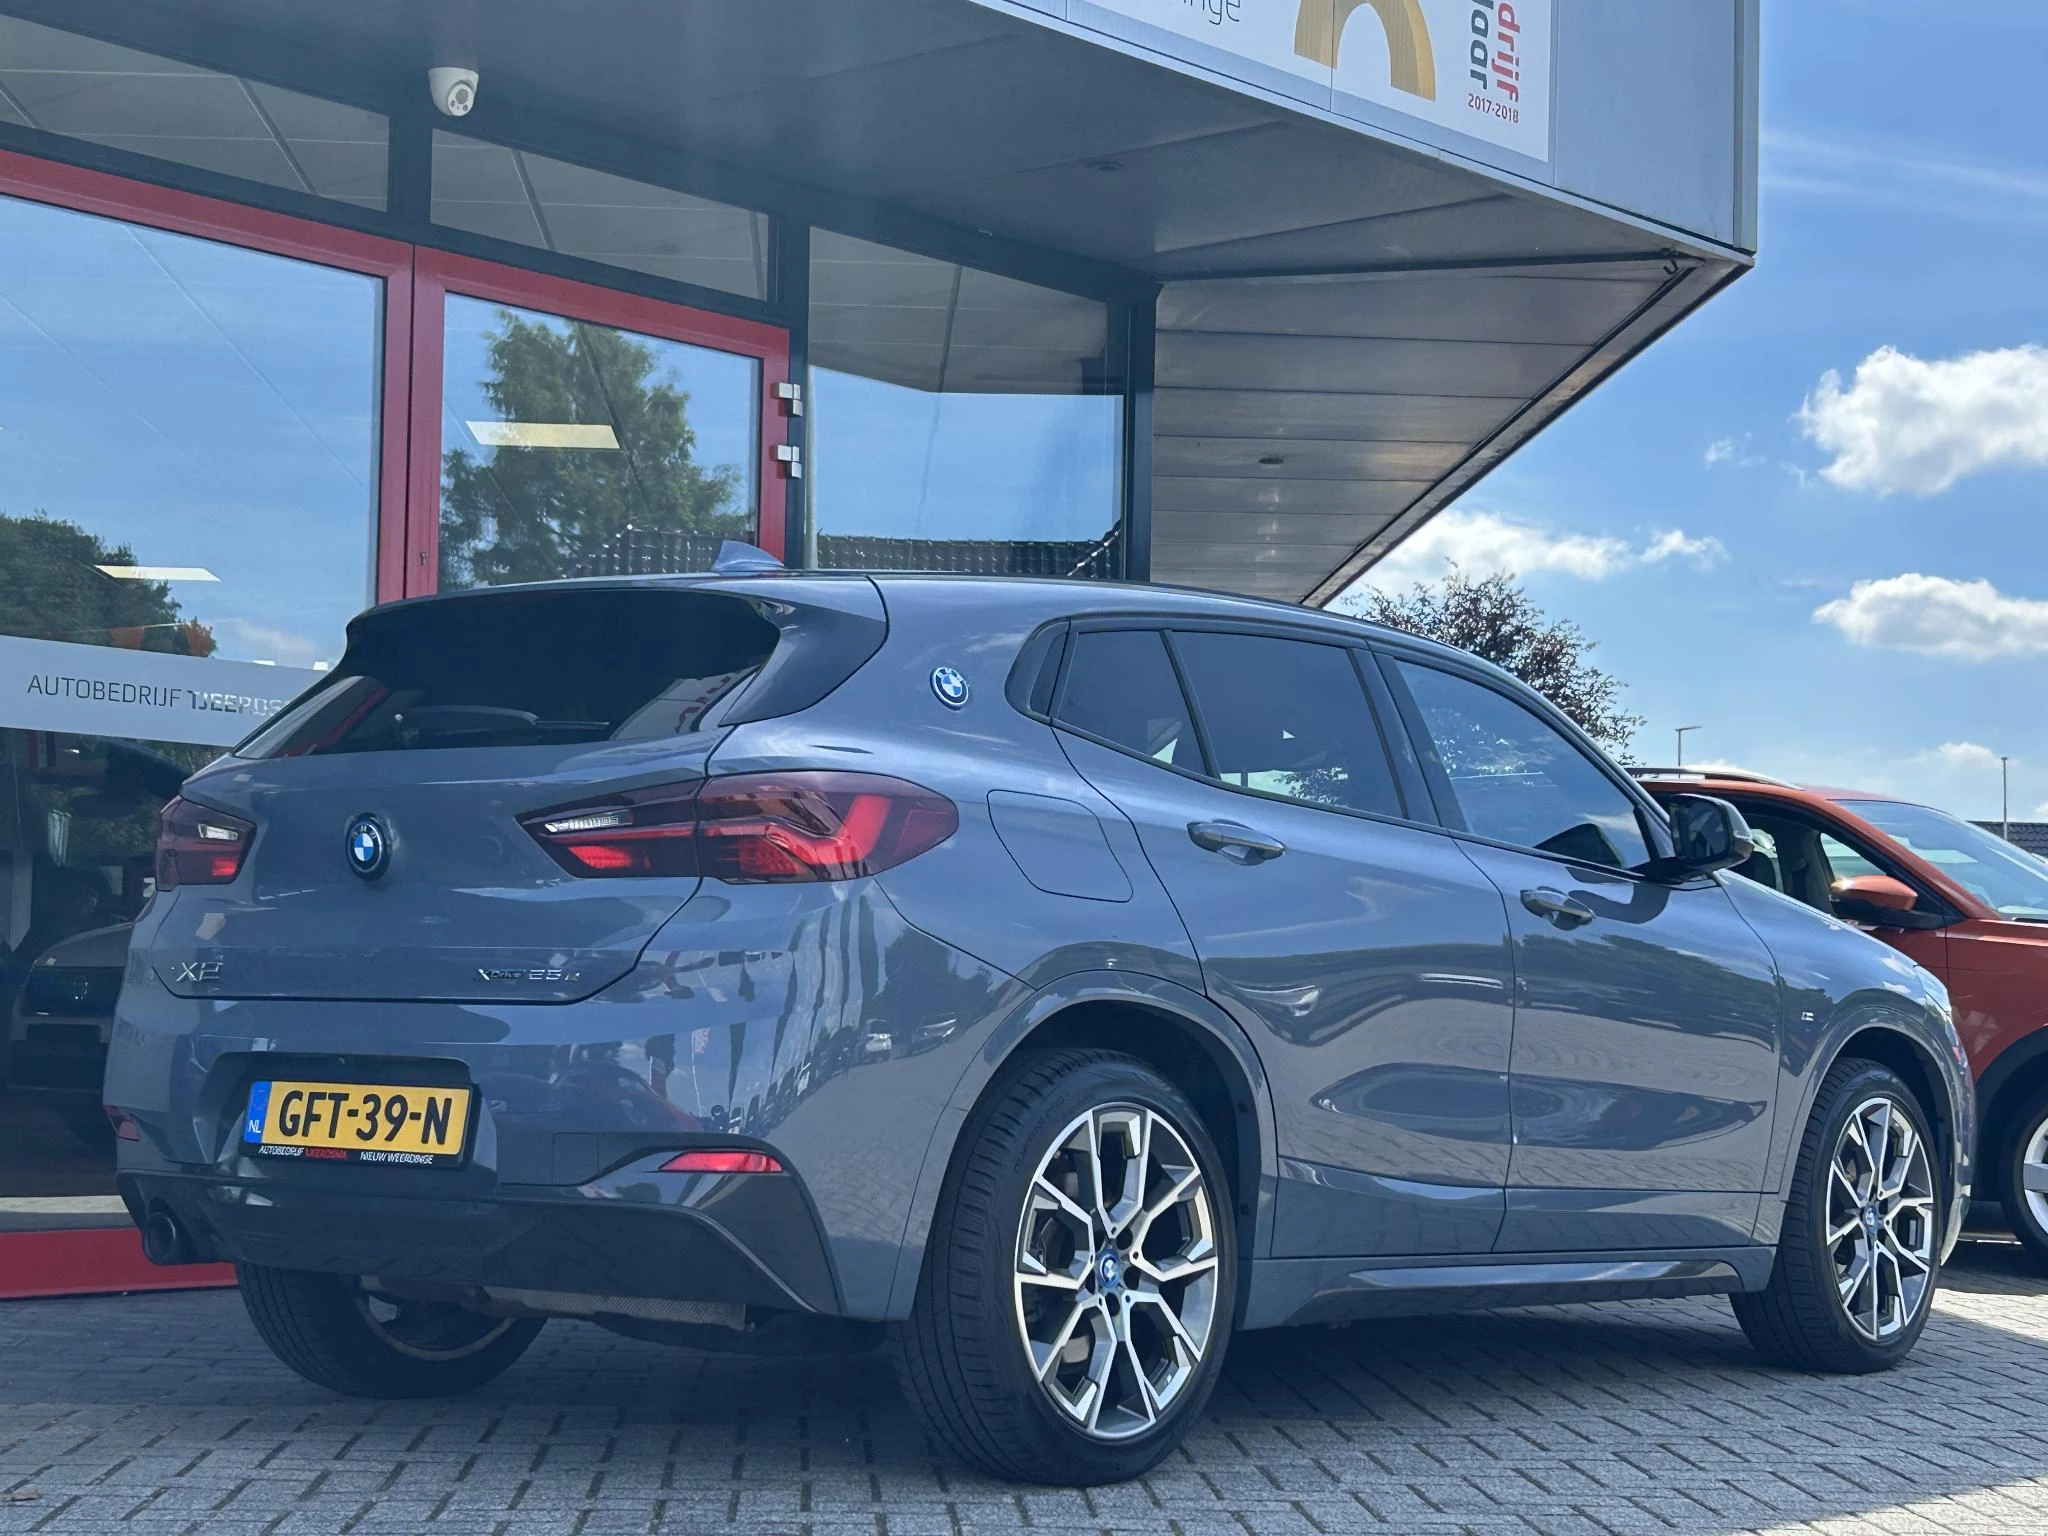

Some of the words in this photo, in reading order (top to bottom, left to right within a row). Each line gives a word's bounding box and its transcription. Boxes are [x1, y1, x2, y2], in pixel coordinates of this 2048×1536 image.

[27, 674, 182, 707] AUTOBEDRIJF
[187, 690, 292, 716] TJEERDS
[176, 961, 223, 981] X2
[249, 1119, 262, 1133] NL
[279, 1090, 453, 1145] GFT-39-N
